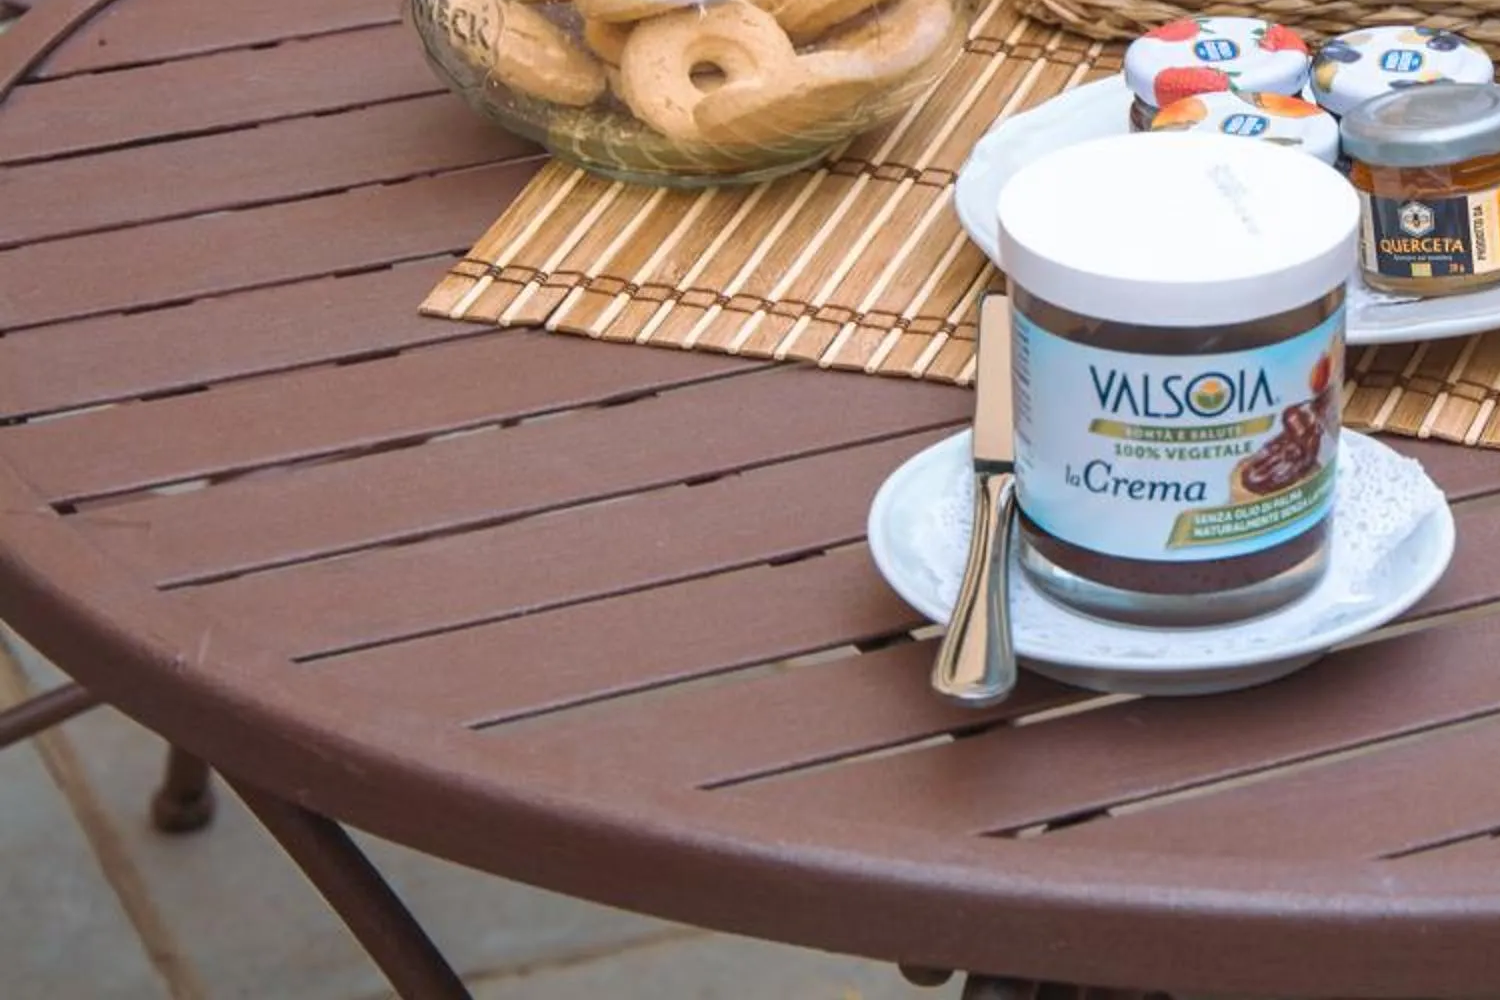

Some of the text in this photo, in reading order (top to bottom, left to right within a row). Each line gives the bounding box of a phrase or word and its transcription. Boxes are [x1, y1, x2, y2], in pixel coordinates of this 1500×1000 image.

[1379, 237, 1465, 255] QUERCETA
[1089, 364, 1275, 419] VALSOIA
[1114, 439, 1253, 461] 100% VEGETALE
[1064, 458, 1209, 502] la Crema
